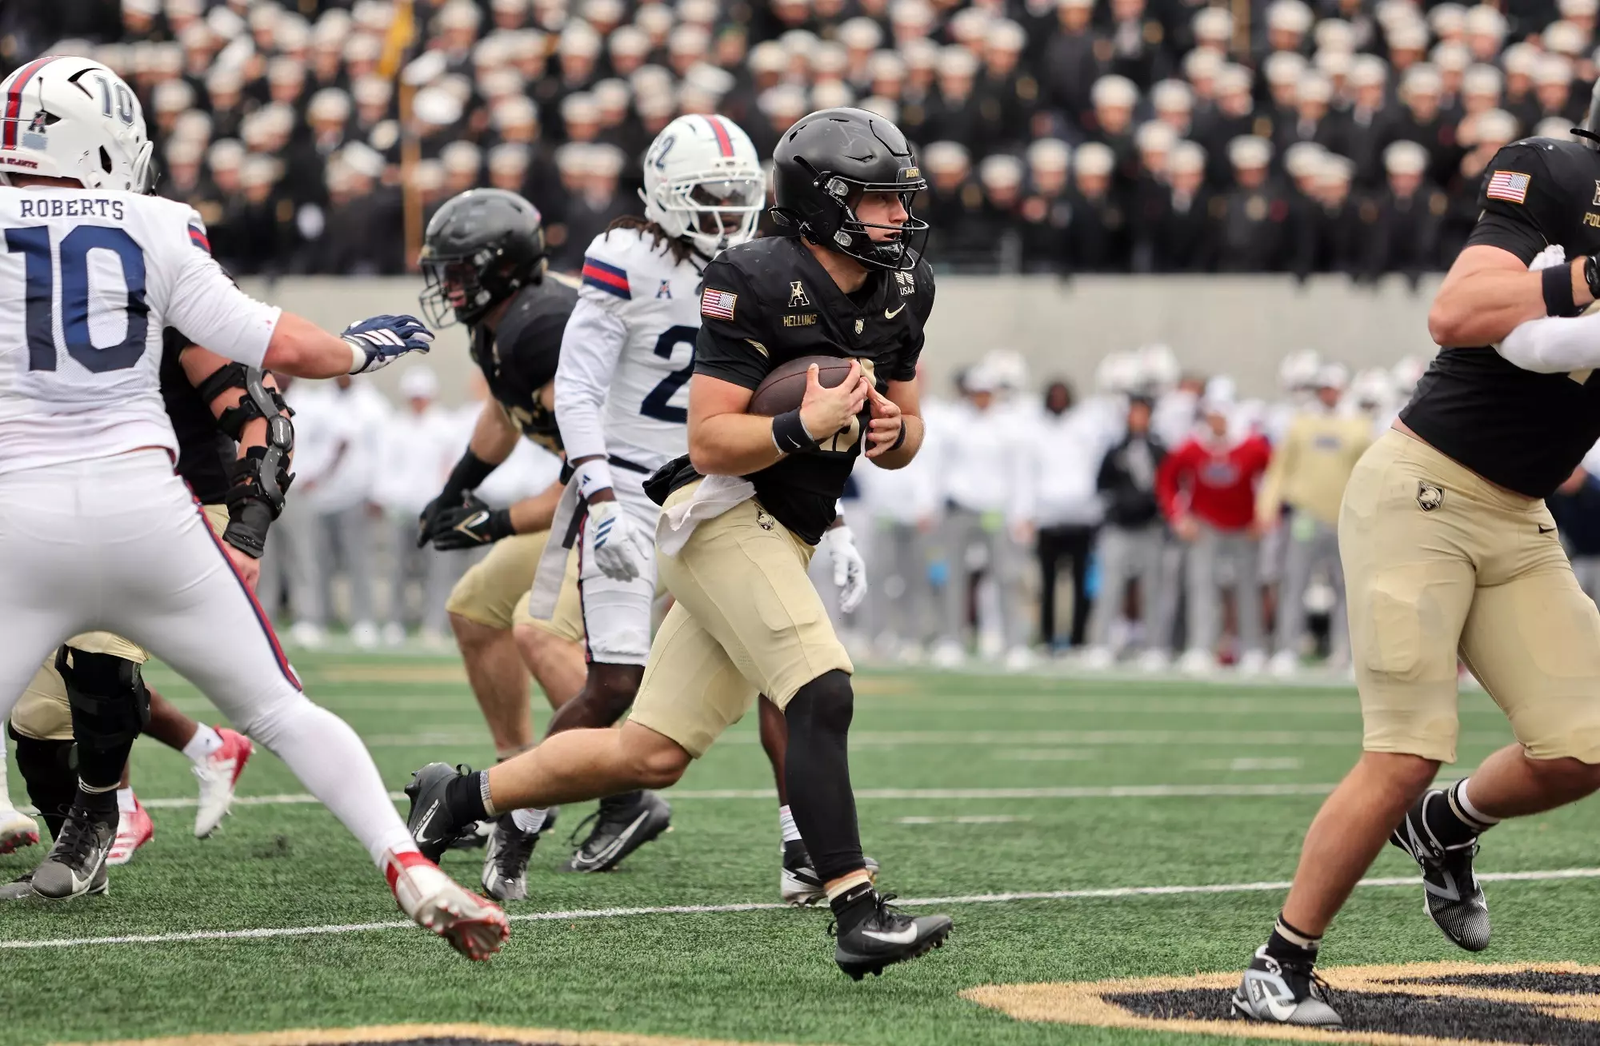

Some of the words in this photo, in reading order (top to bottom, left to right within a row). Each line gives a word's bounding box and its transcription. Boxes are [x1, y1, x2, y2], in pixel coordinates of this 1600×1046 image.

[93, 75, 135, 128] 10
[20, 199, 124, 221] ROBERTS
[4, 225, 150, 373] 10
[900, 286, 915, 296] USAA
[783, 314, 818, 327] HELLUMS
